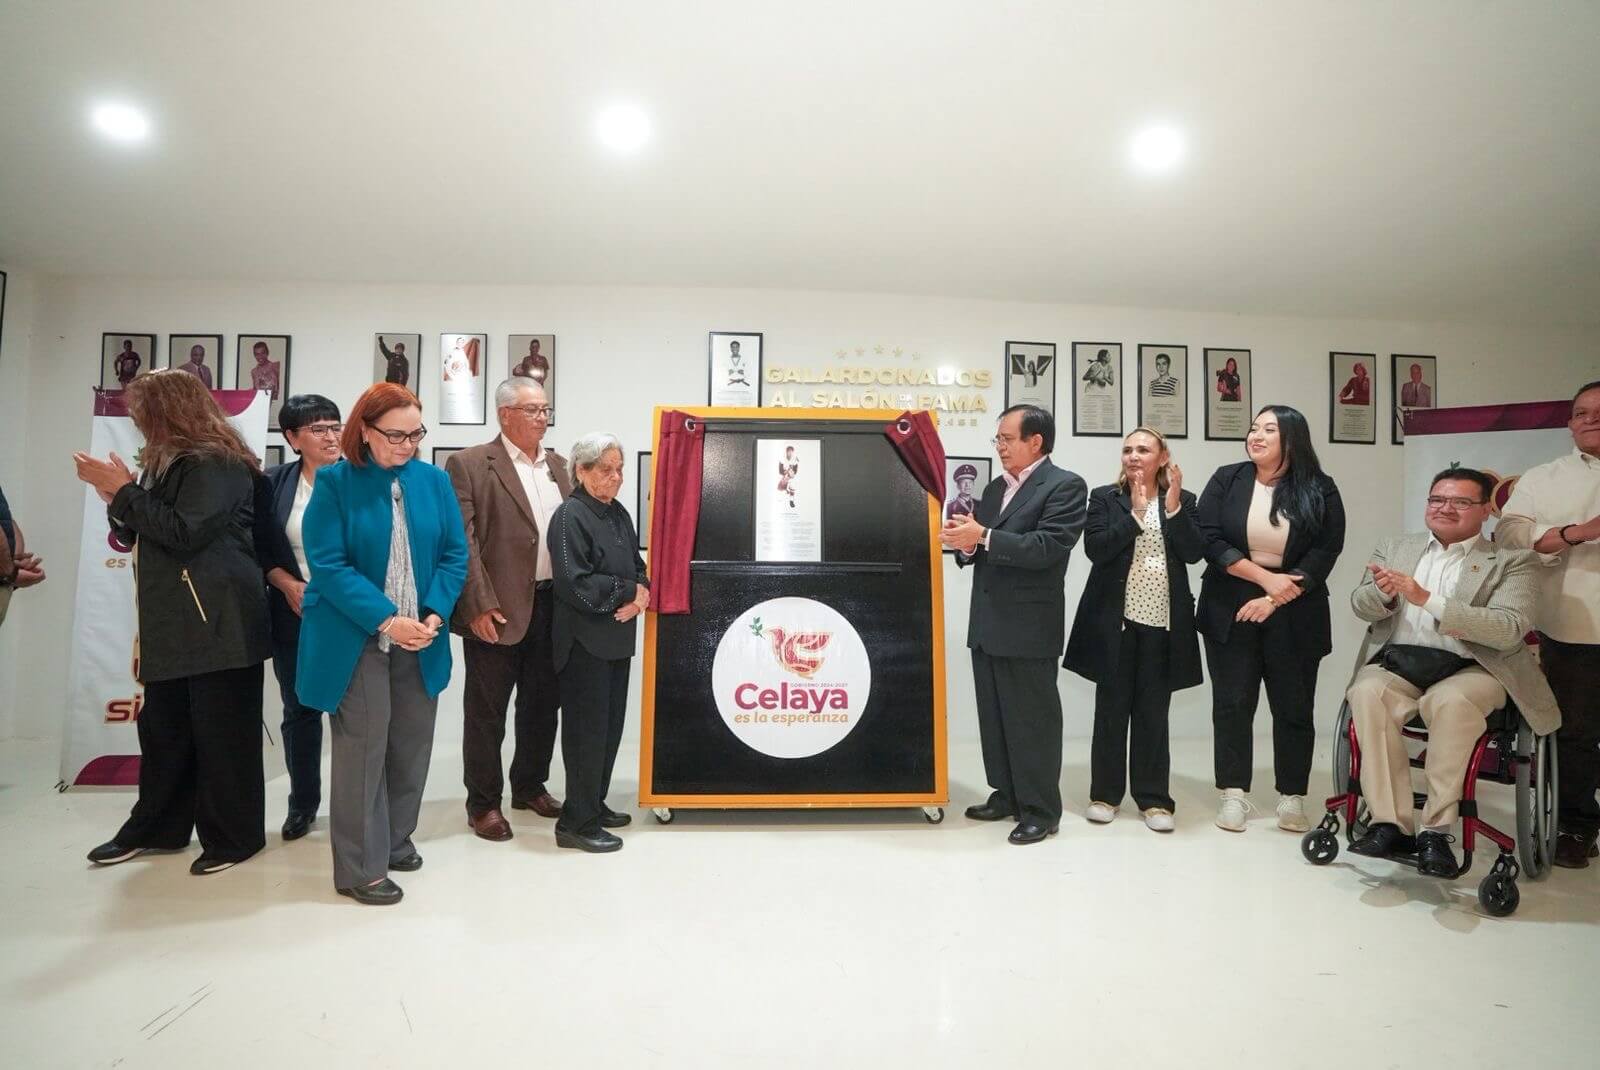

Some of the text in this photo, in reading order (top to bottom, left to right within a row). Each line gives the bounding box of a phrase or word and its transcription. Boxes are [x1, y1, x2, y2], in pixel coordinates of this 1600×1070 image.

[767, 368, 992, 388] GALARDONADOS
[771, 390, 803, 408] AL
[811, 388, 895, 409] SALÓN
[917, 392, 987, 413] FAMA
[105, 558, 127, 569] es
[735, 682, 849, 714] Celaya
[735, 712, 849, 727] es la esperanza
